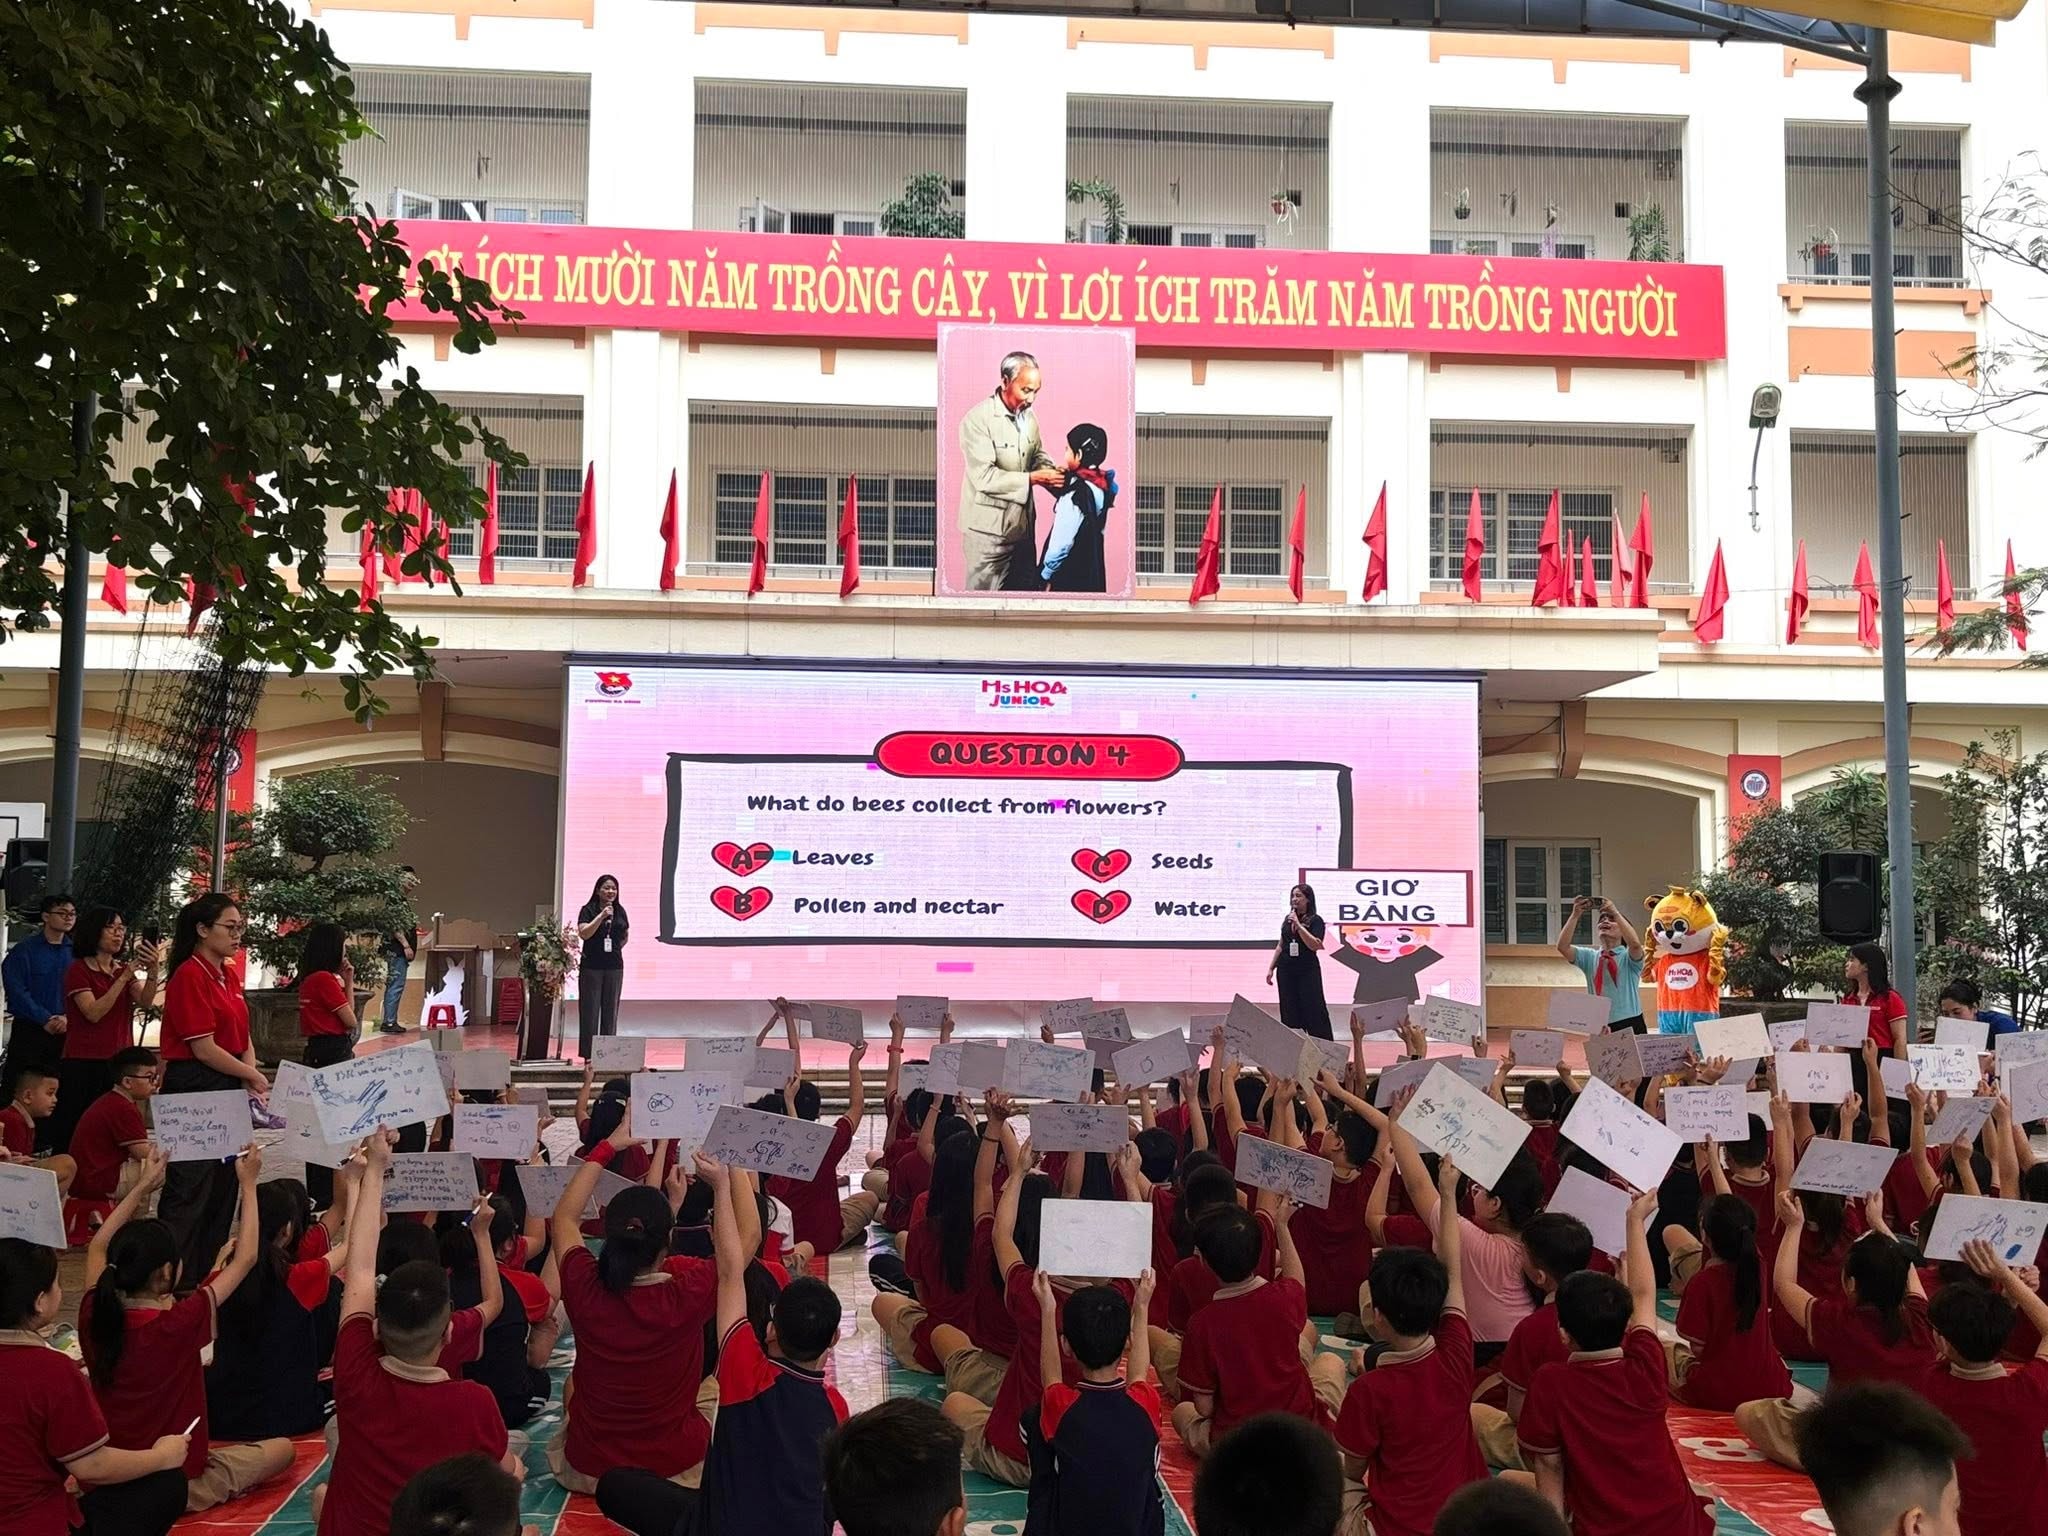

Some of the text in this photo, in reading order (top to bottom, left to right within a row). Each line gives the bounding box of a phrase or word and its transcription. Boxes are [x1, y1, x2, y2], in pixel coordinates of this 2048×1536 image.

[472, 235, 544, 302] ÍCH
[554, 240, 655, 305] MƯỜI
[667, 246, 759, 309] NĂM
[767, 240, 902, 315] TRỒNG
[912, 253, 996, 326] CÂY,
[1008, 257, 1048, 319] VÌ
[1135, 258, 1200, 324] ÍCH
[1210, 265, 1318, 327] TRĂM
[1328, 267, 1413, 329] NĂM
[1424, 259, 1553, 334] TRỒNG
[1563, 274, 1678, 338] NGƯỜI
[1014, 681, 1067, 694] HOA
[930, 742, 1130, 766] QUESTION 4
[747, 796, 1167, 816] What do bees collect from flowers?
[731, 850, 874, 870] A Leaves
[1092, 853, 1214, 878] C Seeds
[1355, 879, 1420, 897] GIƠ
[733, 894, 1005, 915] B Pollen and nectar
[1093, 899, 1227, 919] D Water
[1338, 900, 1436, 922] BẢNG
